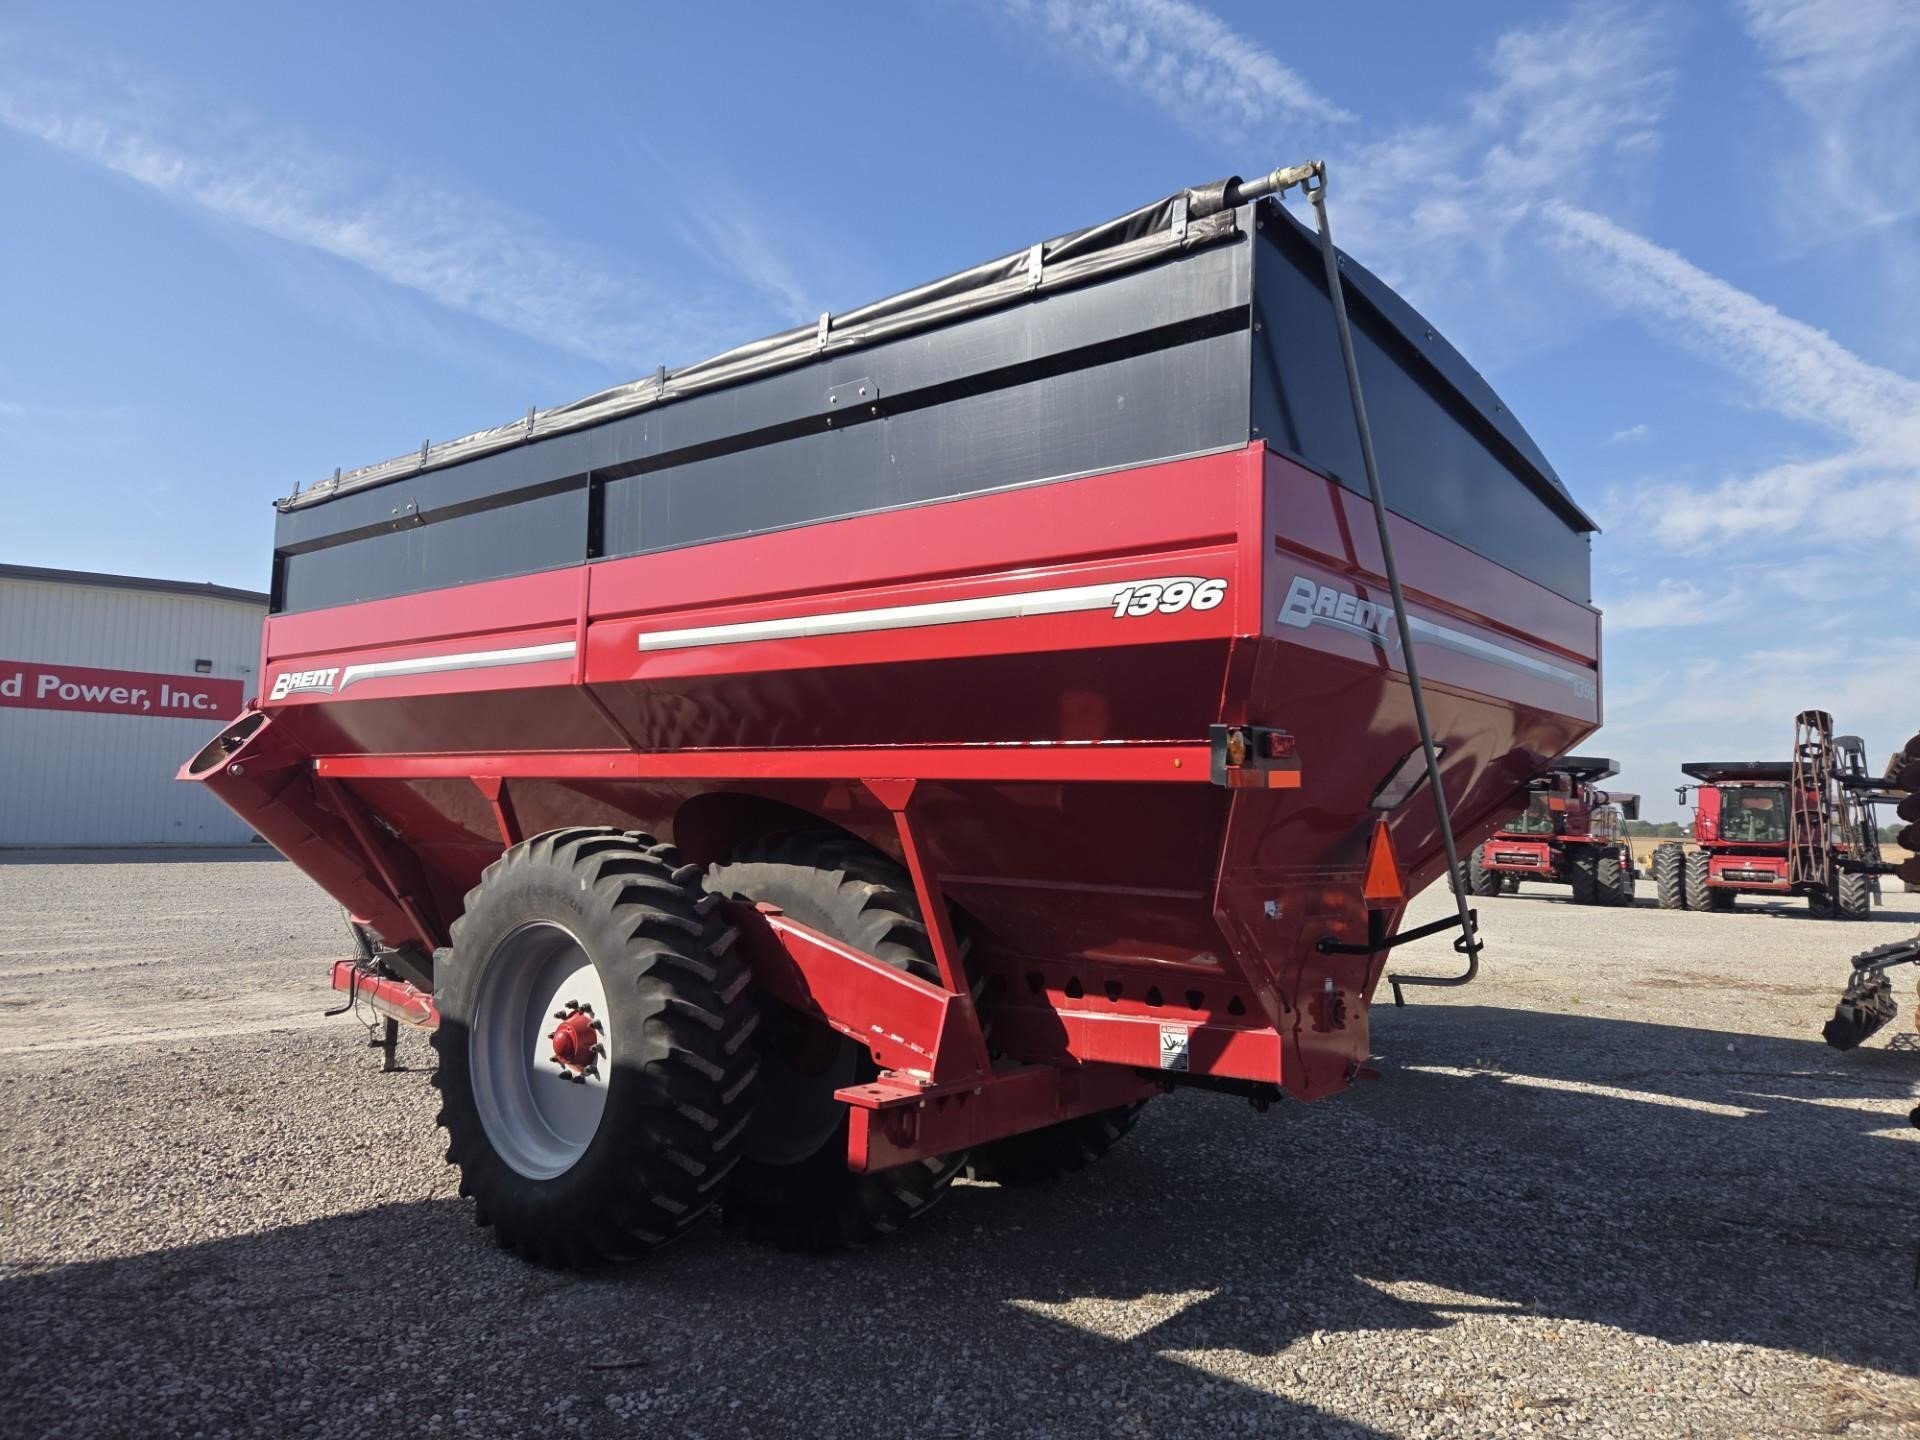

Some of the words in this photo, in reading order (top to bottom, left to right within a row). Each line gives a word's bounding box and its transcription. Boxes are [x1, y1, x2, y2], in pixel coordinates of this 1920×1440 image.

[1112, 578, 1228, 618] 1396
[36, 674, 151, 710] Power,
[160, 684, 218, 710] Inc.
